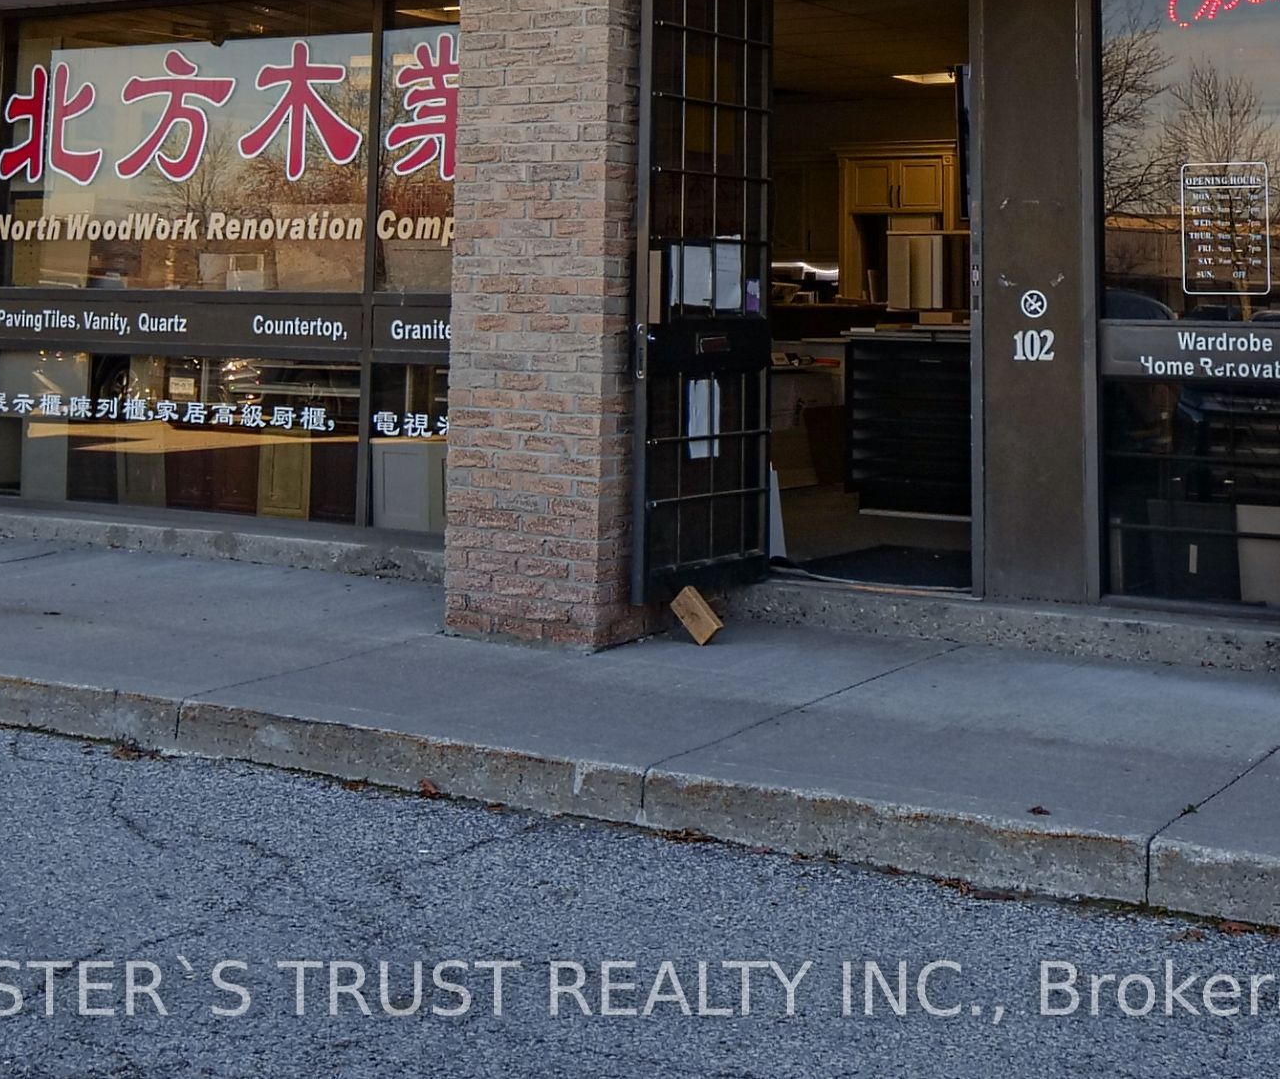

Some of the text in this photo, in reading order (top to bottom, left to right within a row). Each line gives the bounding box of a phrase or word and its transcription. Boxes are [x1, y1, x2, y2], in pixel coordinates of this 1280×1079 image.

[1185, 176, 1261, 185] OPENING HOURS
[67, 212, 200, 241] WoodWork
[206, 210, 363, 241] Renovation
[83, 311, 131, 335] Vanity,
[138, 313, 187, 332] Quartz
[253, 315, 348, 341] Countertop,
[1013, 329, 1055, 361] 102
[1177, 331, 1273, 352] Wardrobe
